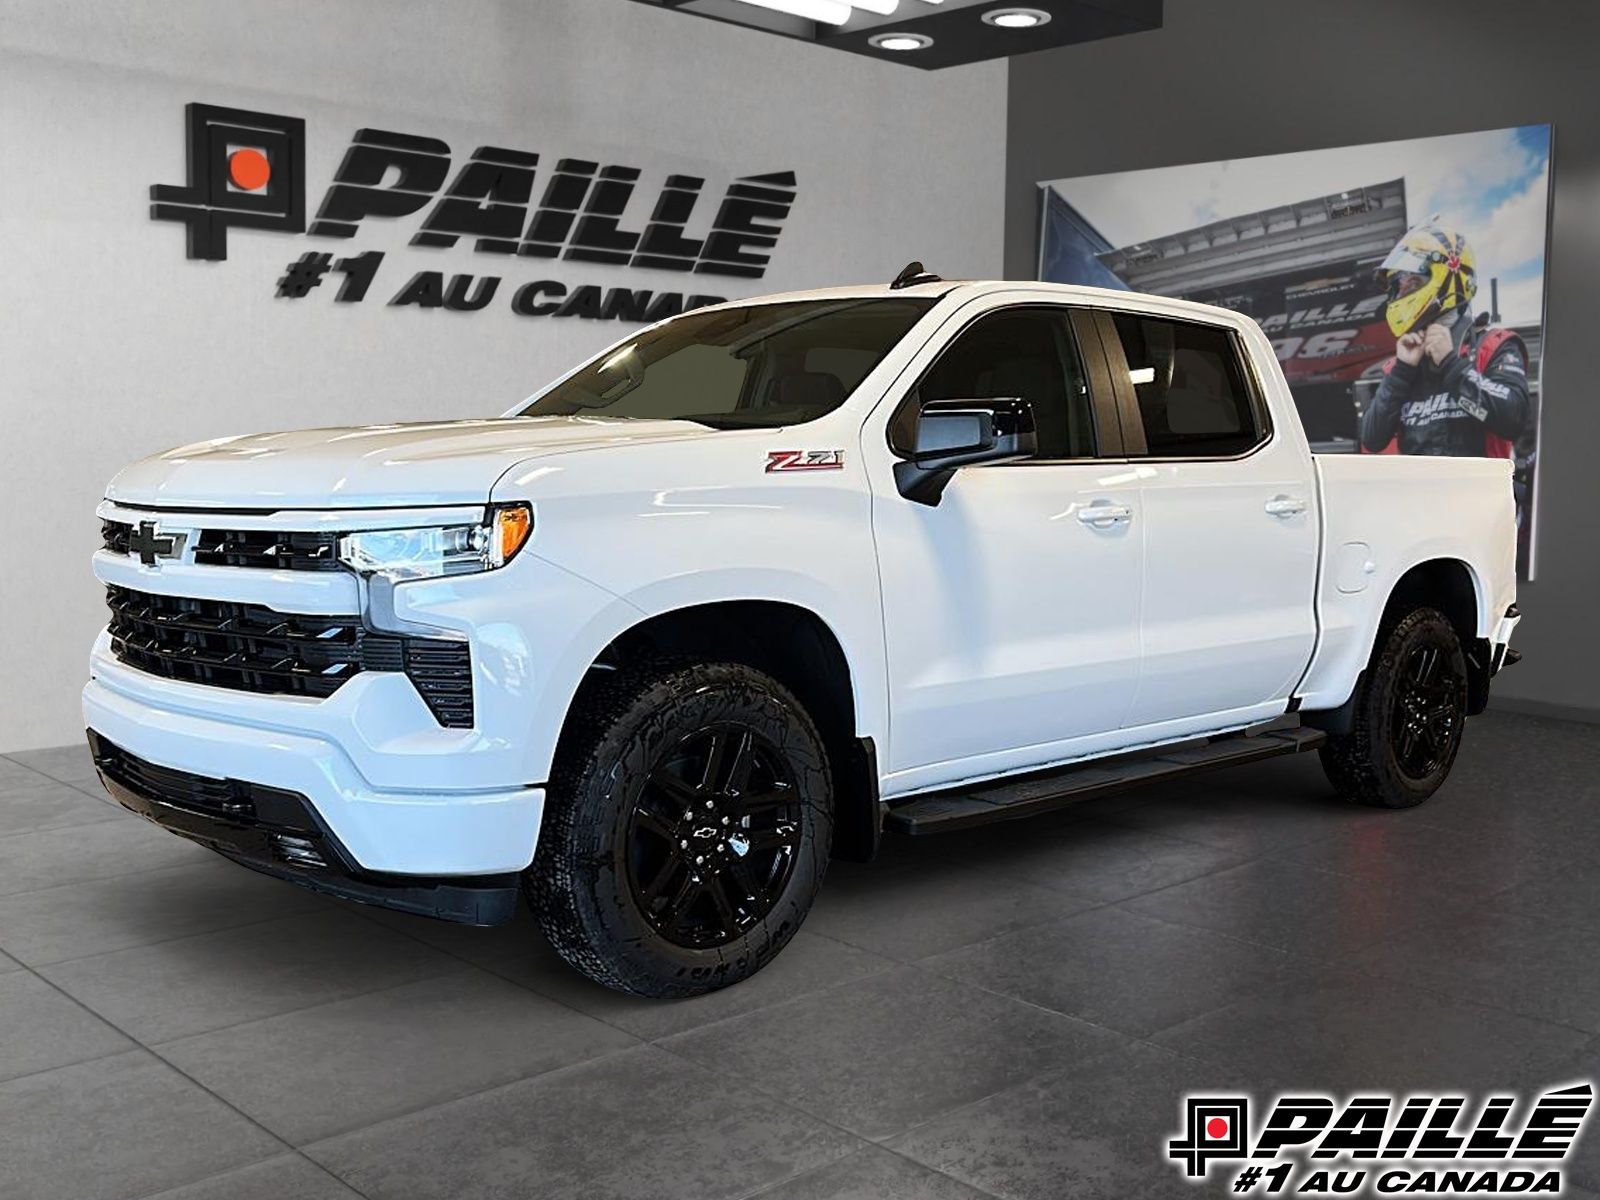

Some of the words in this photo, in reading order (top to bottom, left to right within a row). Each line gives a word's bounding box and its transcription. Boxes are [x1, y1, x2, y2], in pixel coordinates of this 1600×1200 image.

[306, 128, 796, 279] PAILLÉ
[275, 250, 385, 302] #1
[387, 271, 502, 311] AU
[765, 450, 844, 474] Z71
